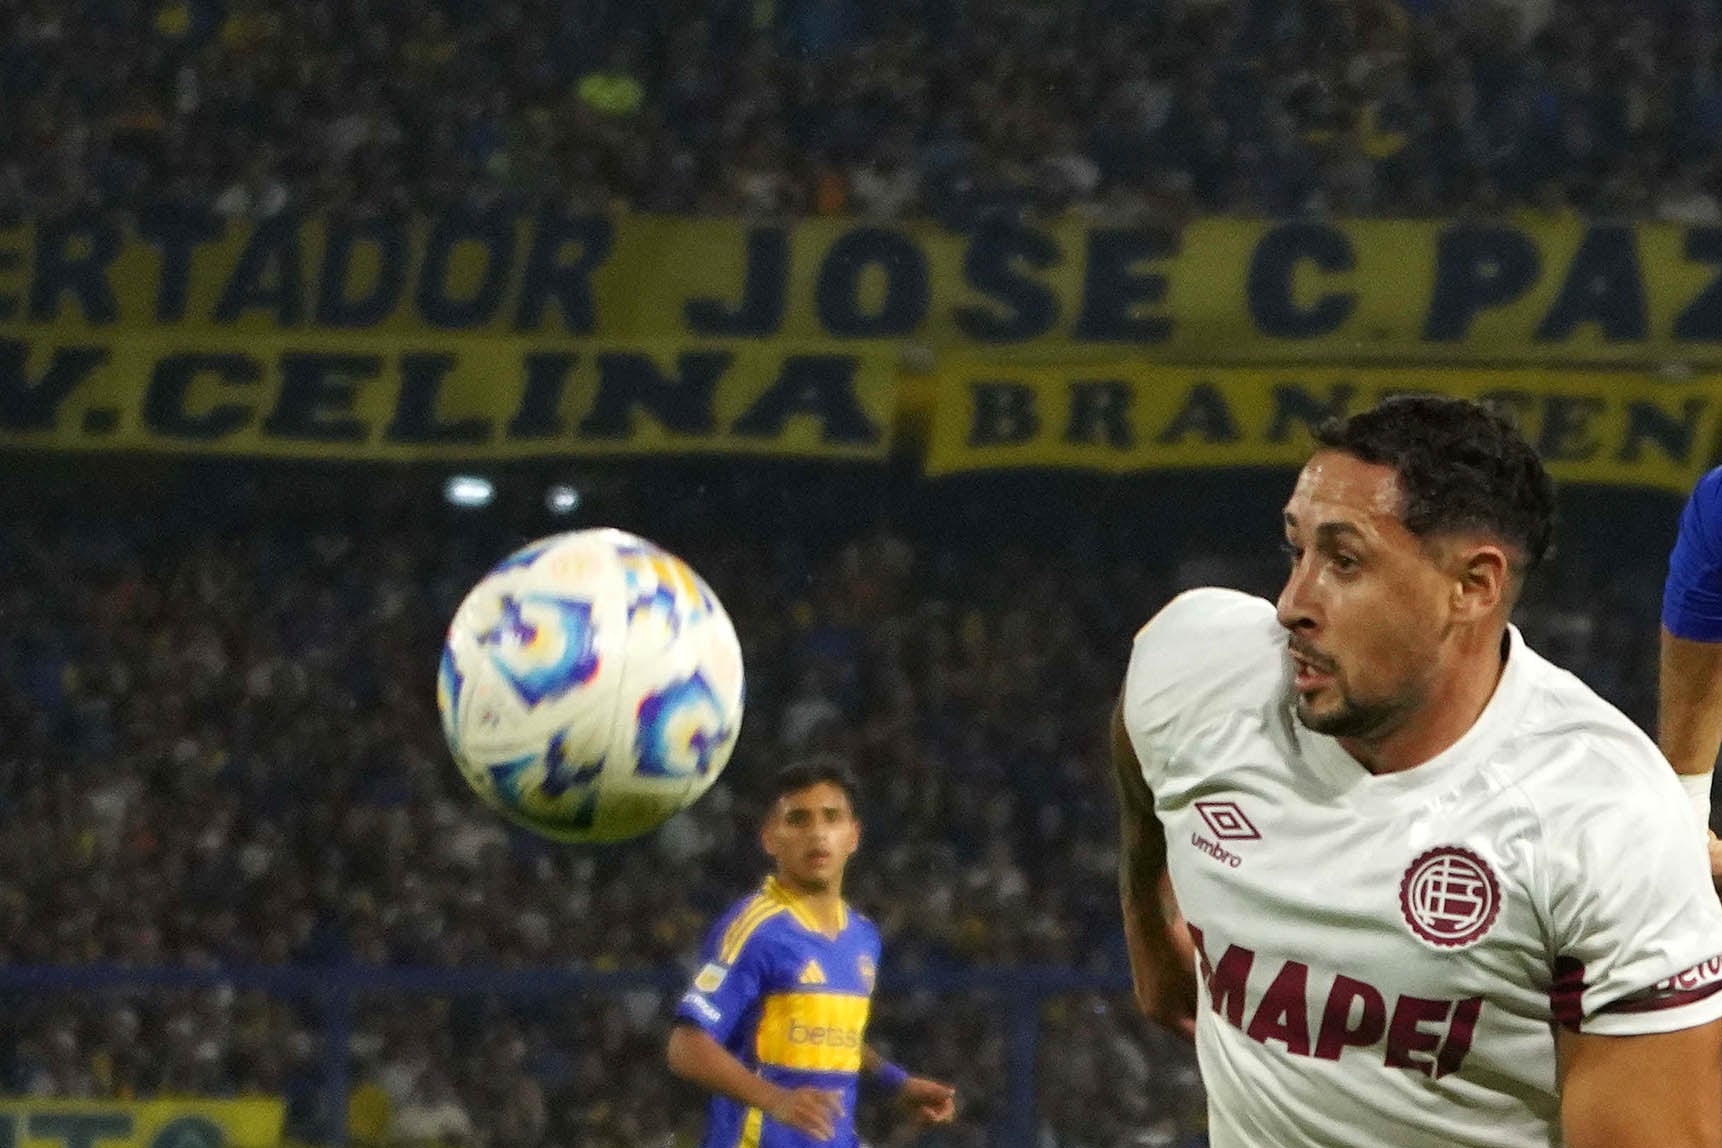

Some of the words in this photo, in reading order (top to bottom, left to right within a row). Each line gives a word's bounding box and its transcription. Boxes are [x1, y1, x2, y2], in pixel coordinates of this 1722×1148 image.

[683, 214, 1183, 342] JOSE
[1247, 222, 1358, 340] C
[967, 379, 1711, 465] BRANEN
[1191, 832, 1242, 868] umbro
[1187, 921, 1485, 1080] MAPEI
